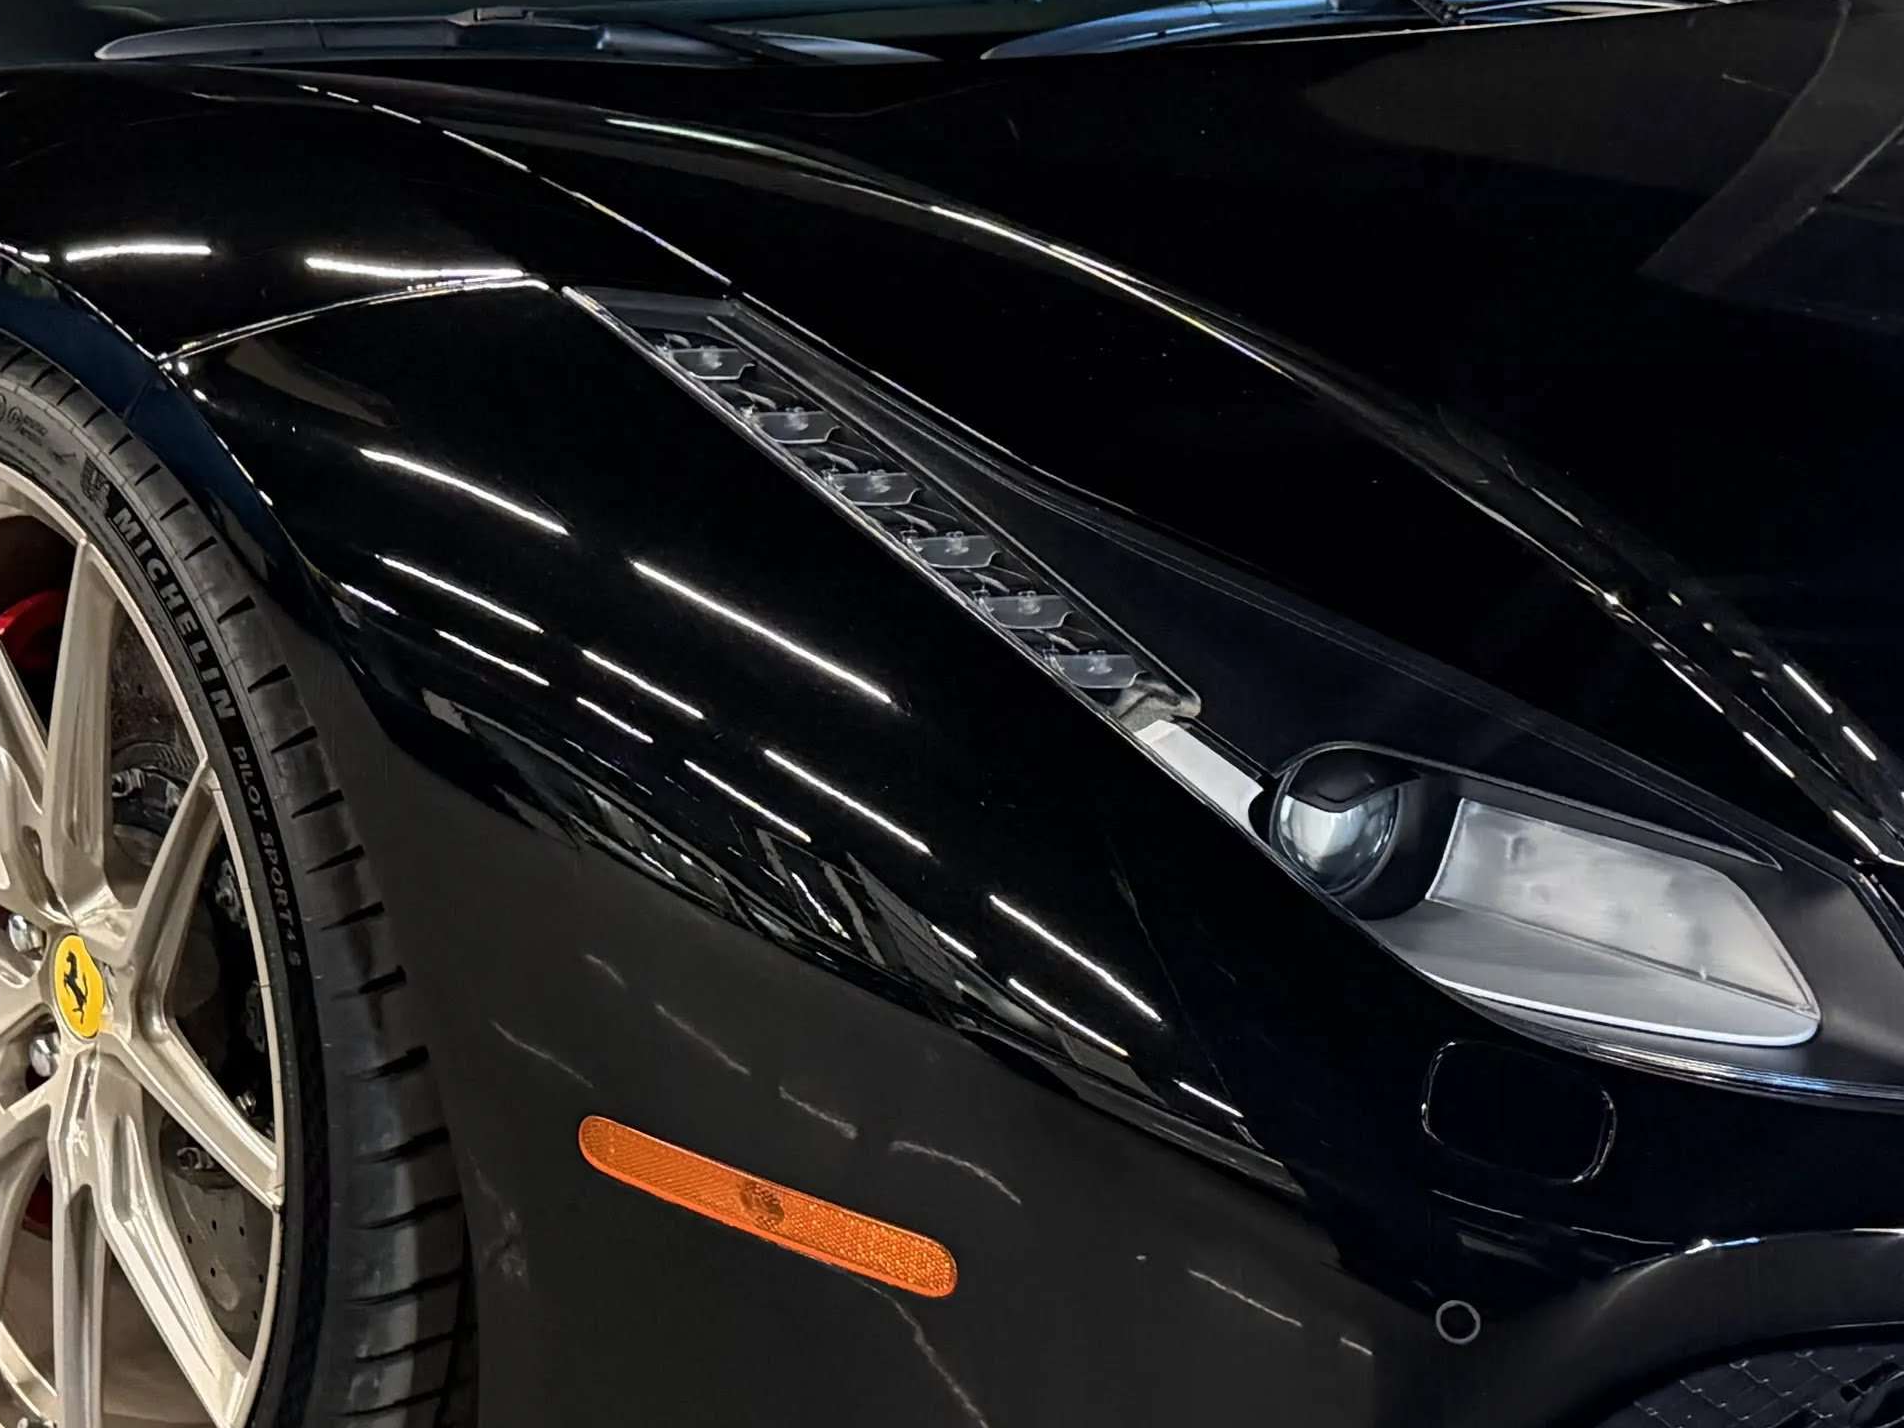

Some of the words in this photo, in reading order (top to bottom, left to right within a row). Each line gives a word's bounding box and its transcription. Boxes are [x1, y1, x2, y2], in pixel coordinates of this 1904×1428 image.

[112, 507, 237, 720] MICHELIN
[232, 745, 268, 821] PILOT
[260, 831, 295, 926] SPORT
